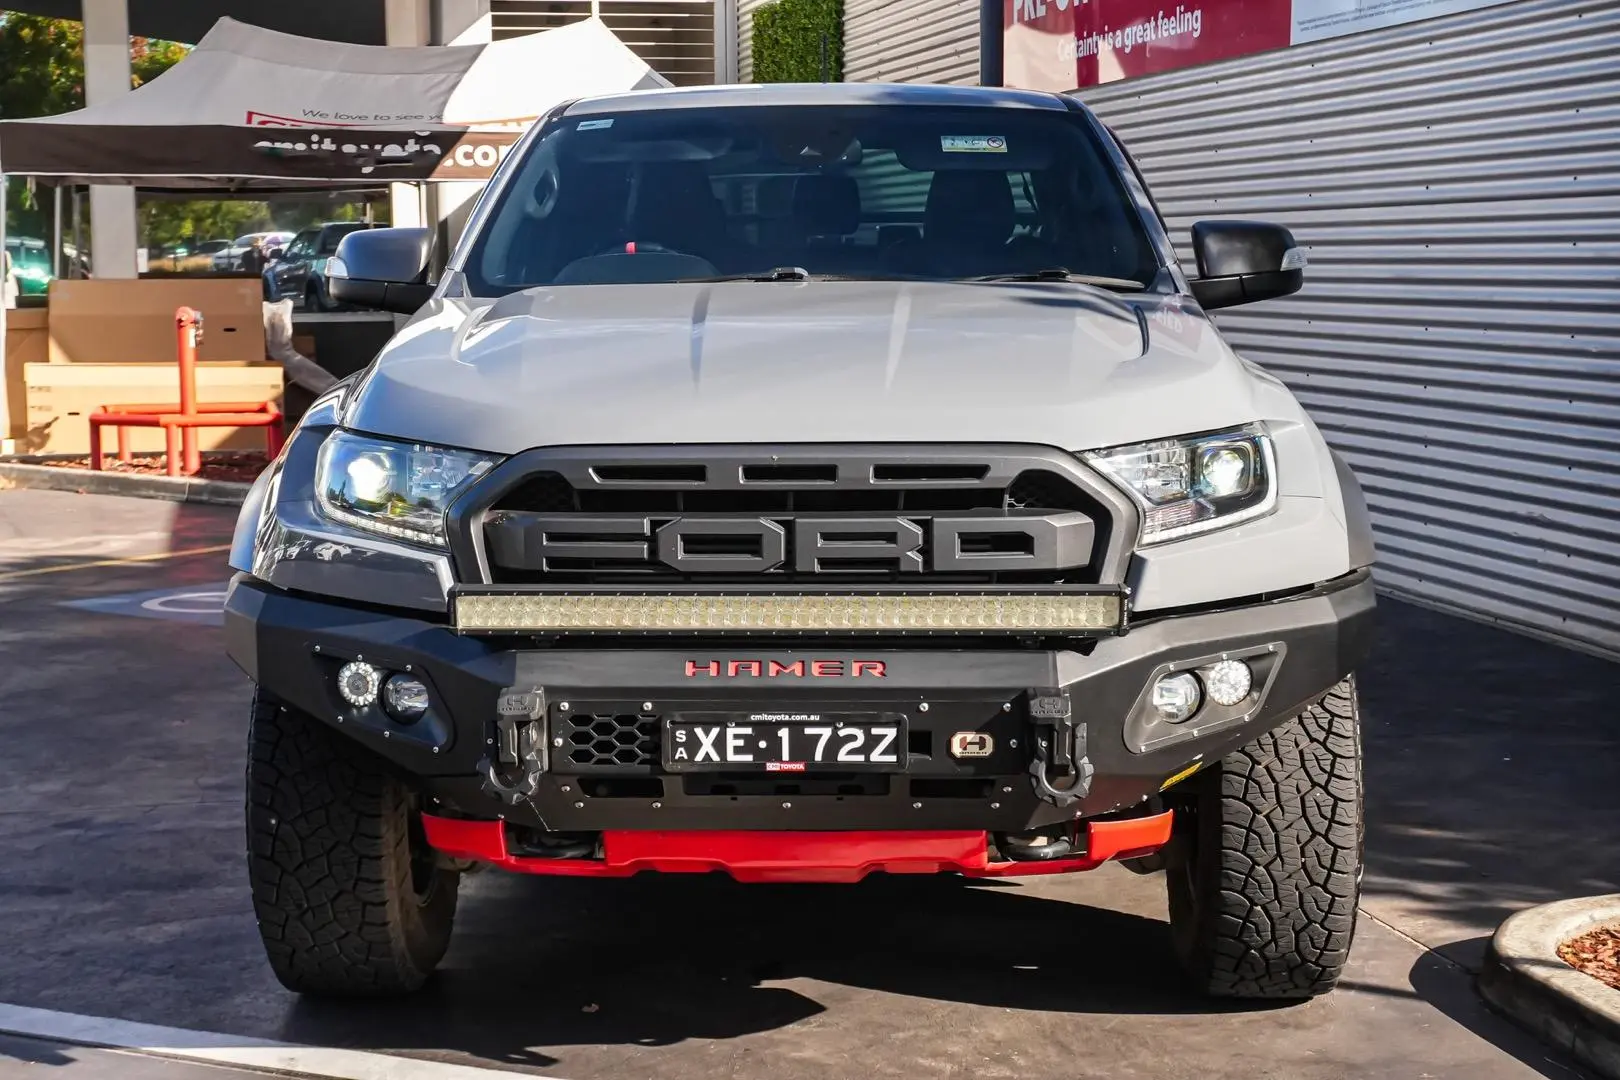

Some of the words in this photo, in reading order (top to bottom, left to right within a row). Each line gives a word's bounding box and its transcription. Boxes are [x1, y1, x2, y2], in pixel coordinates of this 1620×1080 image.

[1058, 31, 1103, 61] Certainty
[1104, 25, 1113, 50] is
[1115, 29, 1122, 48] a
[1124, 17, 1156, 53] great
[1158, 5, 1201, 38] feeling
[302, 109, 329, 117] We
[334, 112, 369, 120] love
[374, 113, 391, 121] to
[488, 513, 1094, 575] FORD
[685, 660, 887, 677] HAMER
[750, 713, 820, 722] cmitoyota.com.au
[780, 763, 805, 771] TOYOTA
